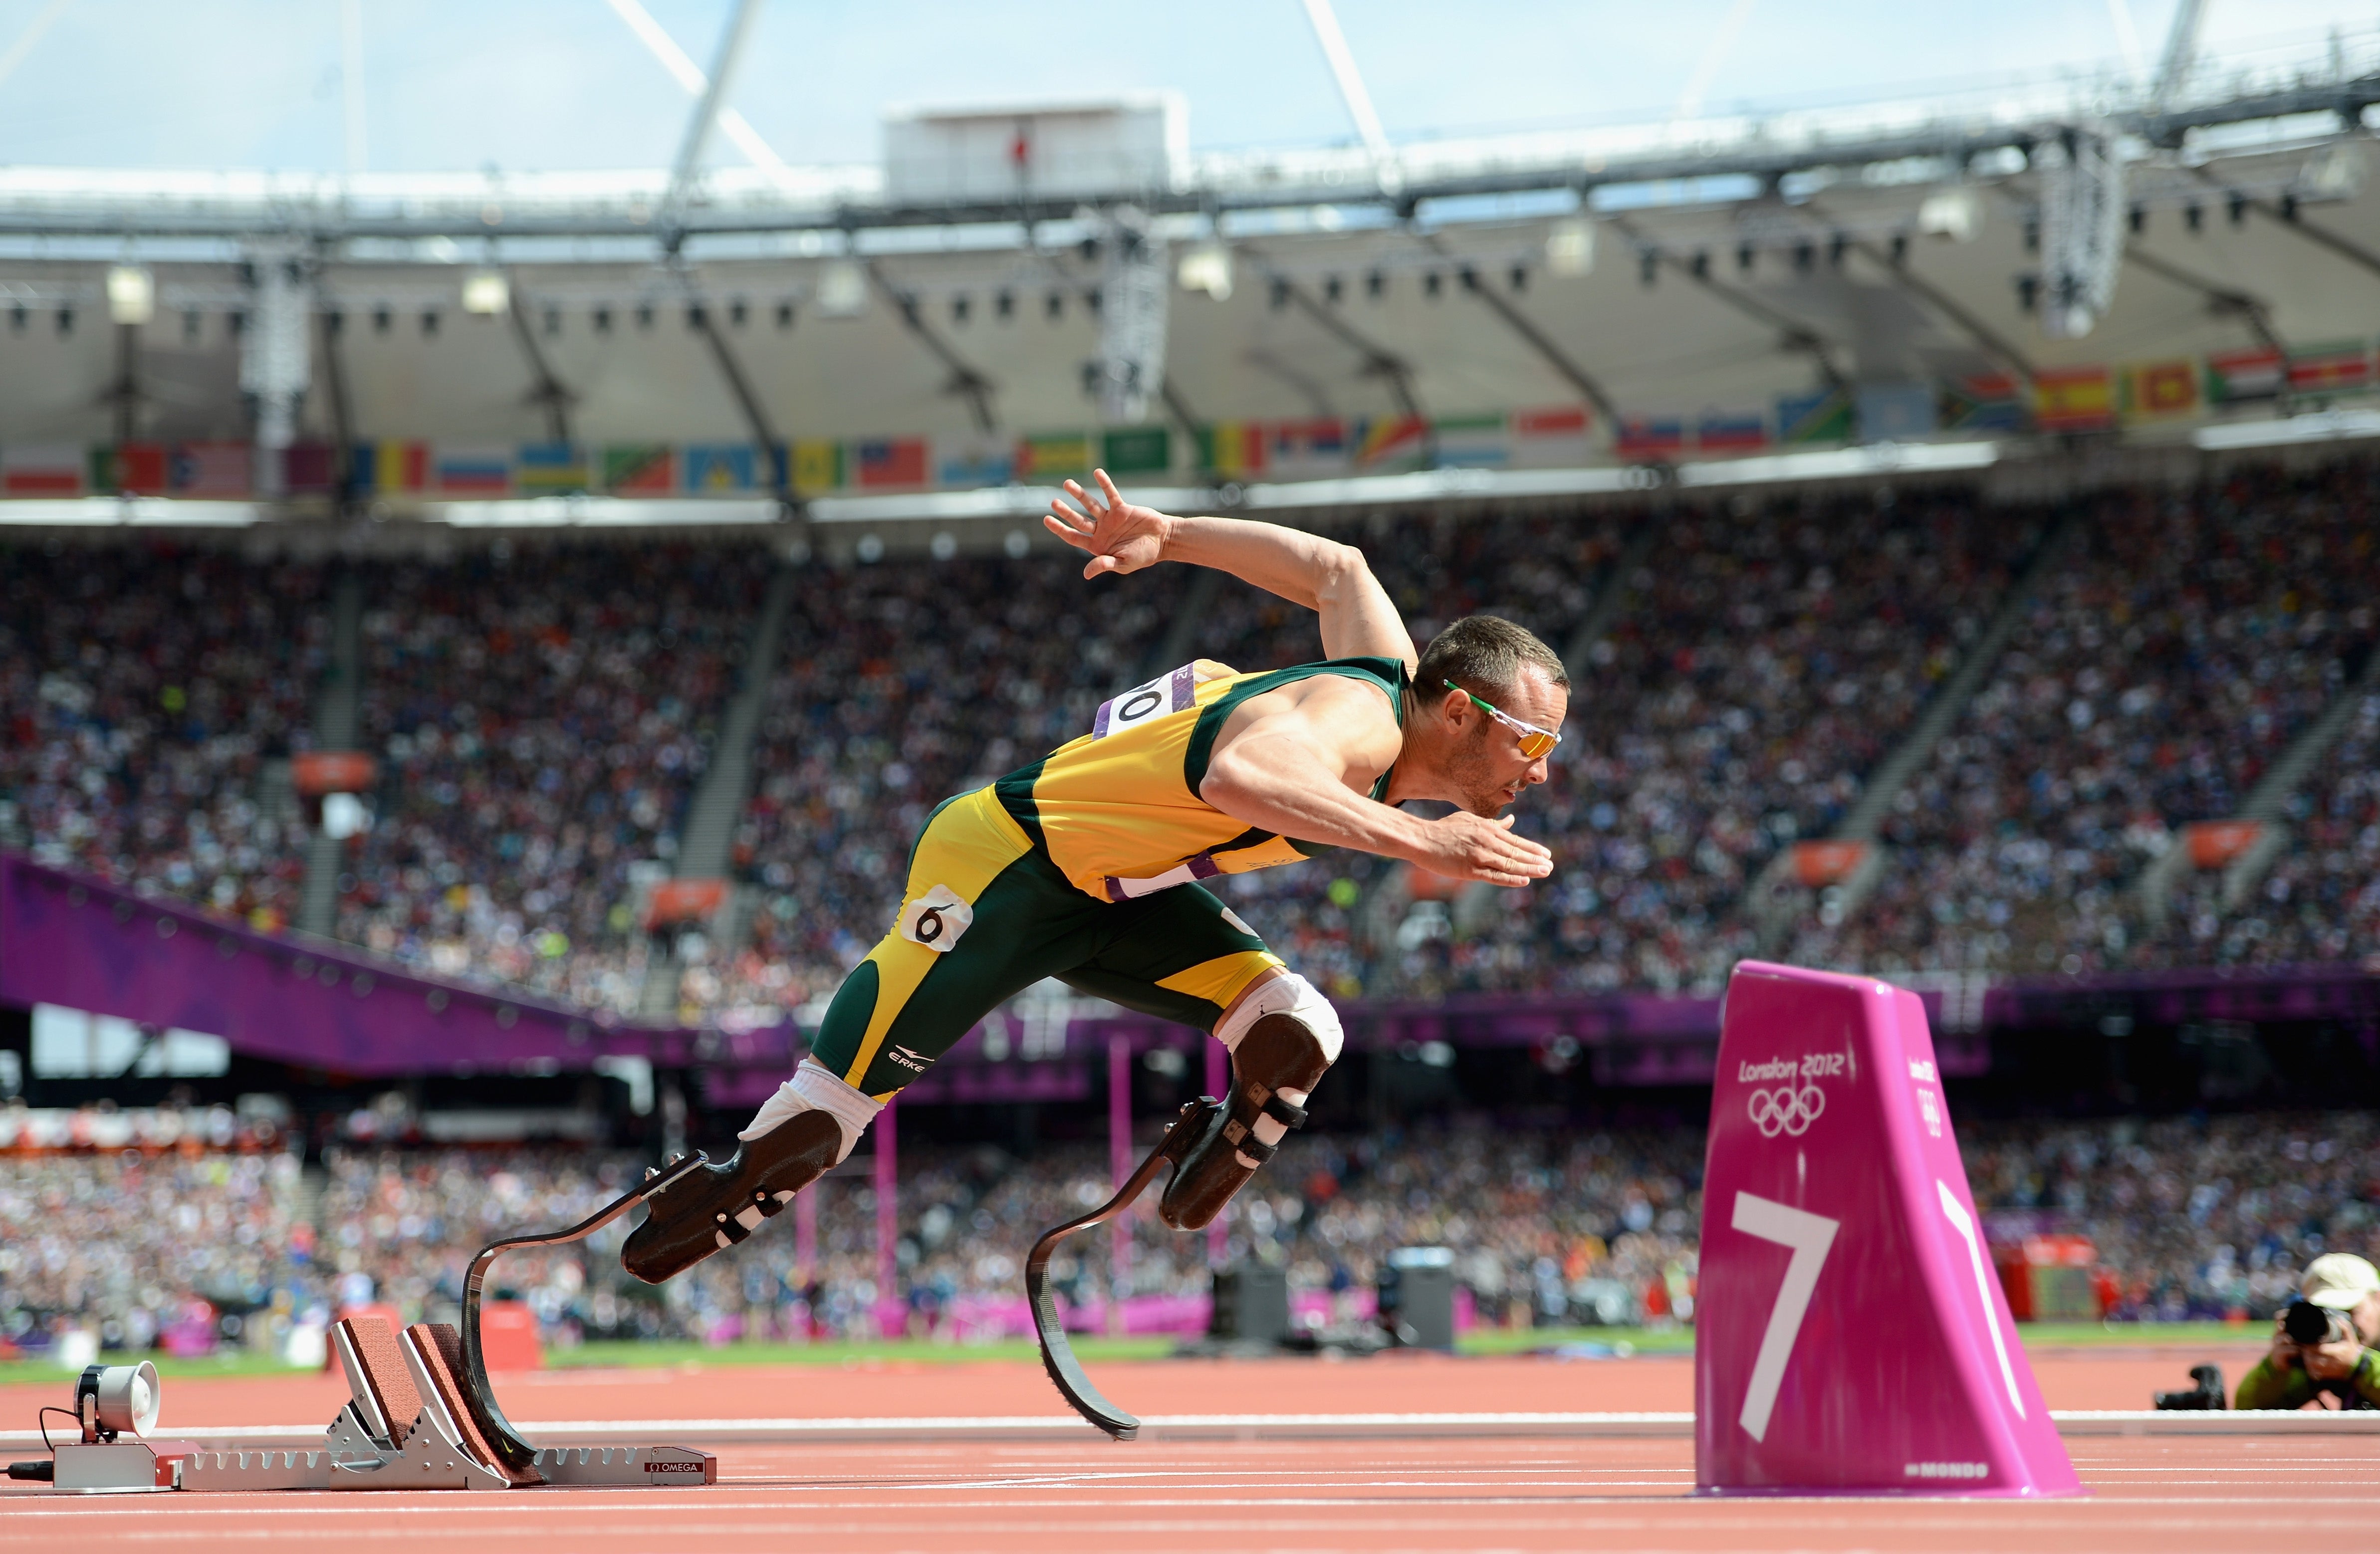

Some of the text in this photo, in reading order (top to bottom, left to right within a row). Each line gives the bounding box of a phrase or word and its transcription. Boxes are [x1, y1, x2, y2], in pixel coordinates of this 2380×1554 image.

[915, 903, 957, 943] 6
[888, 1051, 926, 1073] ERKE
[1738, 1053, 1845, 1083] London 2012
[1731, 1190, 1841, 1443] 7
[662, 1463, 698, 1472] OMEGA
